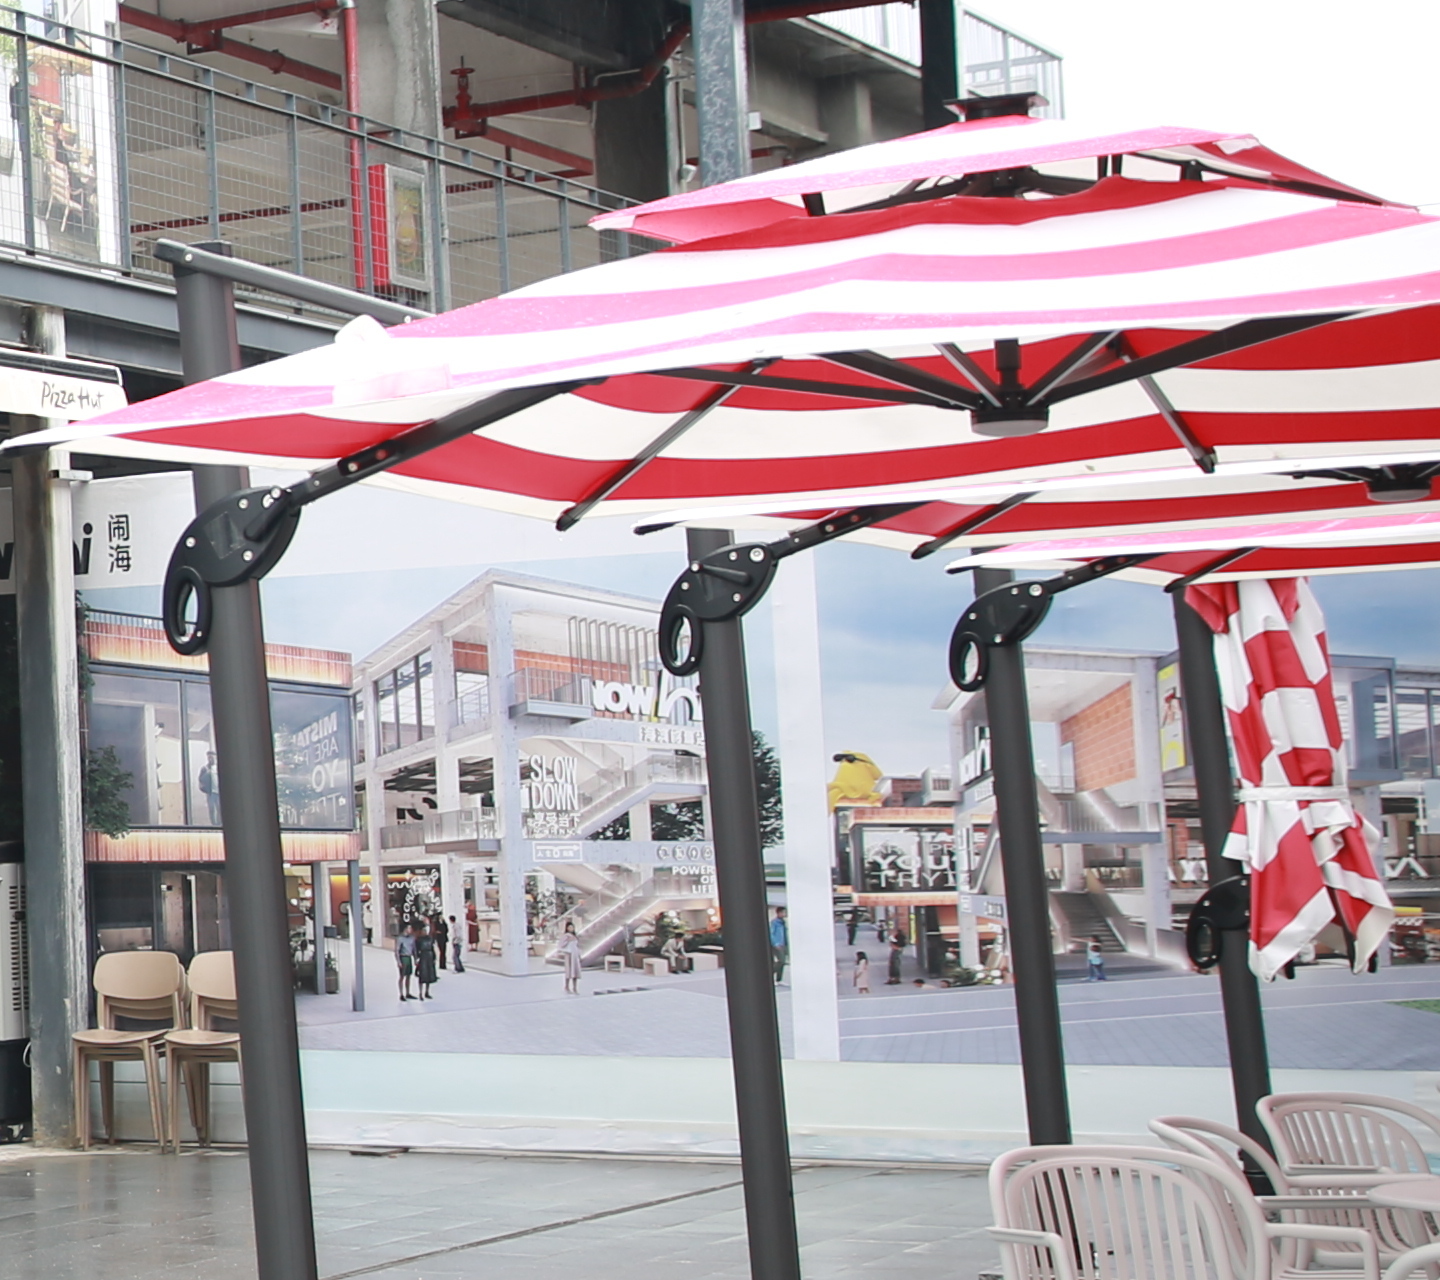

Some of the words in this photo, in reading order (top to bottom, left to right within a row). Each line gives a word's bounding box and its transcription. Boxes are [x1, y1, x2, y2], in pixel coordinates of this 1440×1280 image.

[41, 380, 75, 410] Pizza
[77, 388, 104, 412] Hut
[108, 514, 132, 573] 闹海
[592, 678, 655, 716] NOW
[530, 754, 579, 783] SLOW
[531, 782, 580, 812] DOWN
[533, 812, 582, 829] 享受当下
[672, 865, 715, 875] POWER
[692, 884, 715, 894] LIFE
